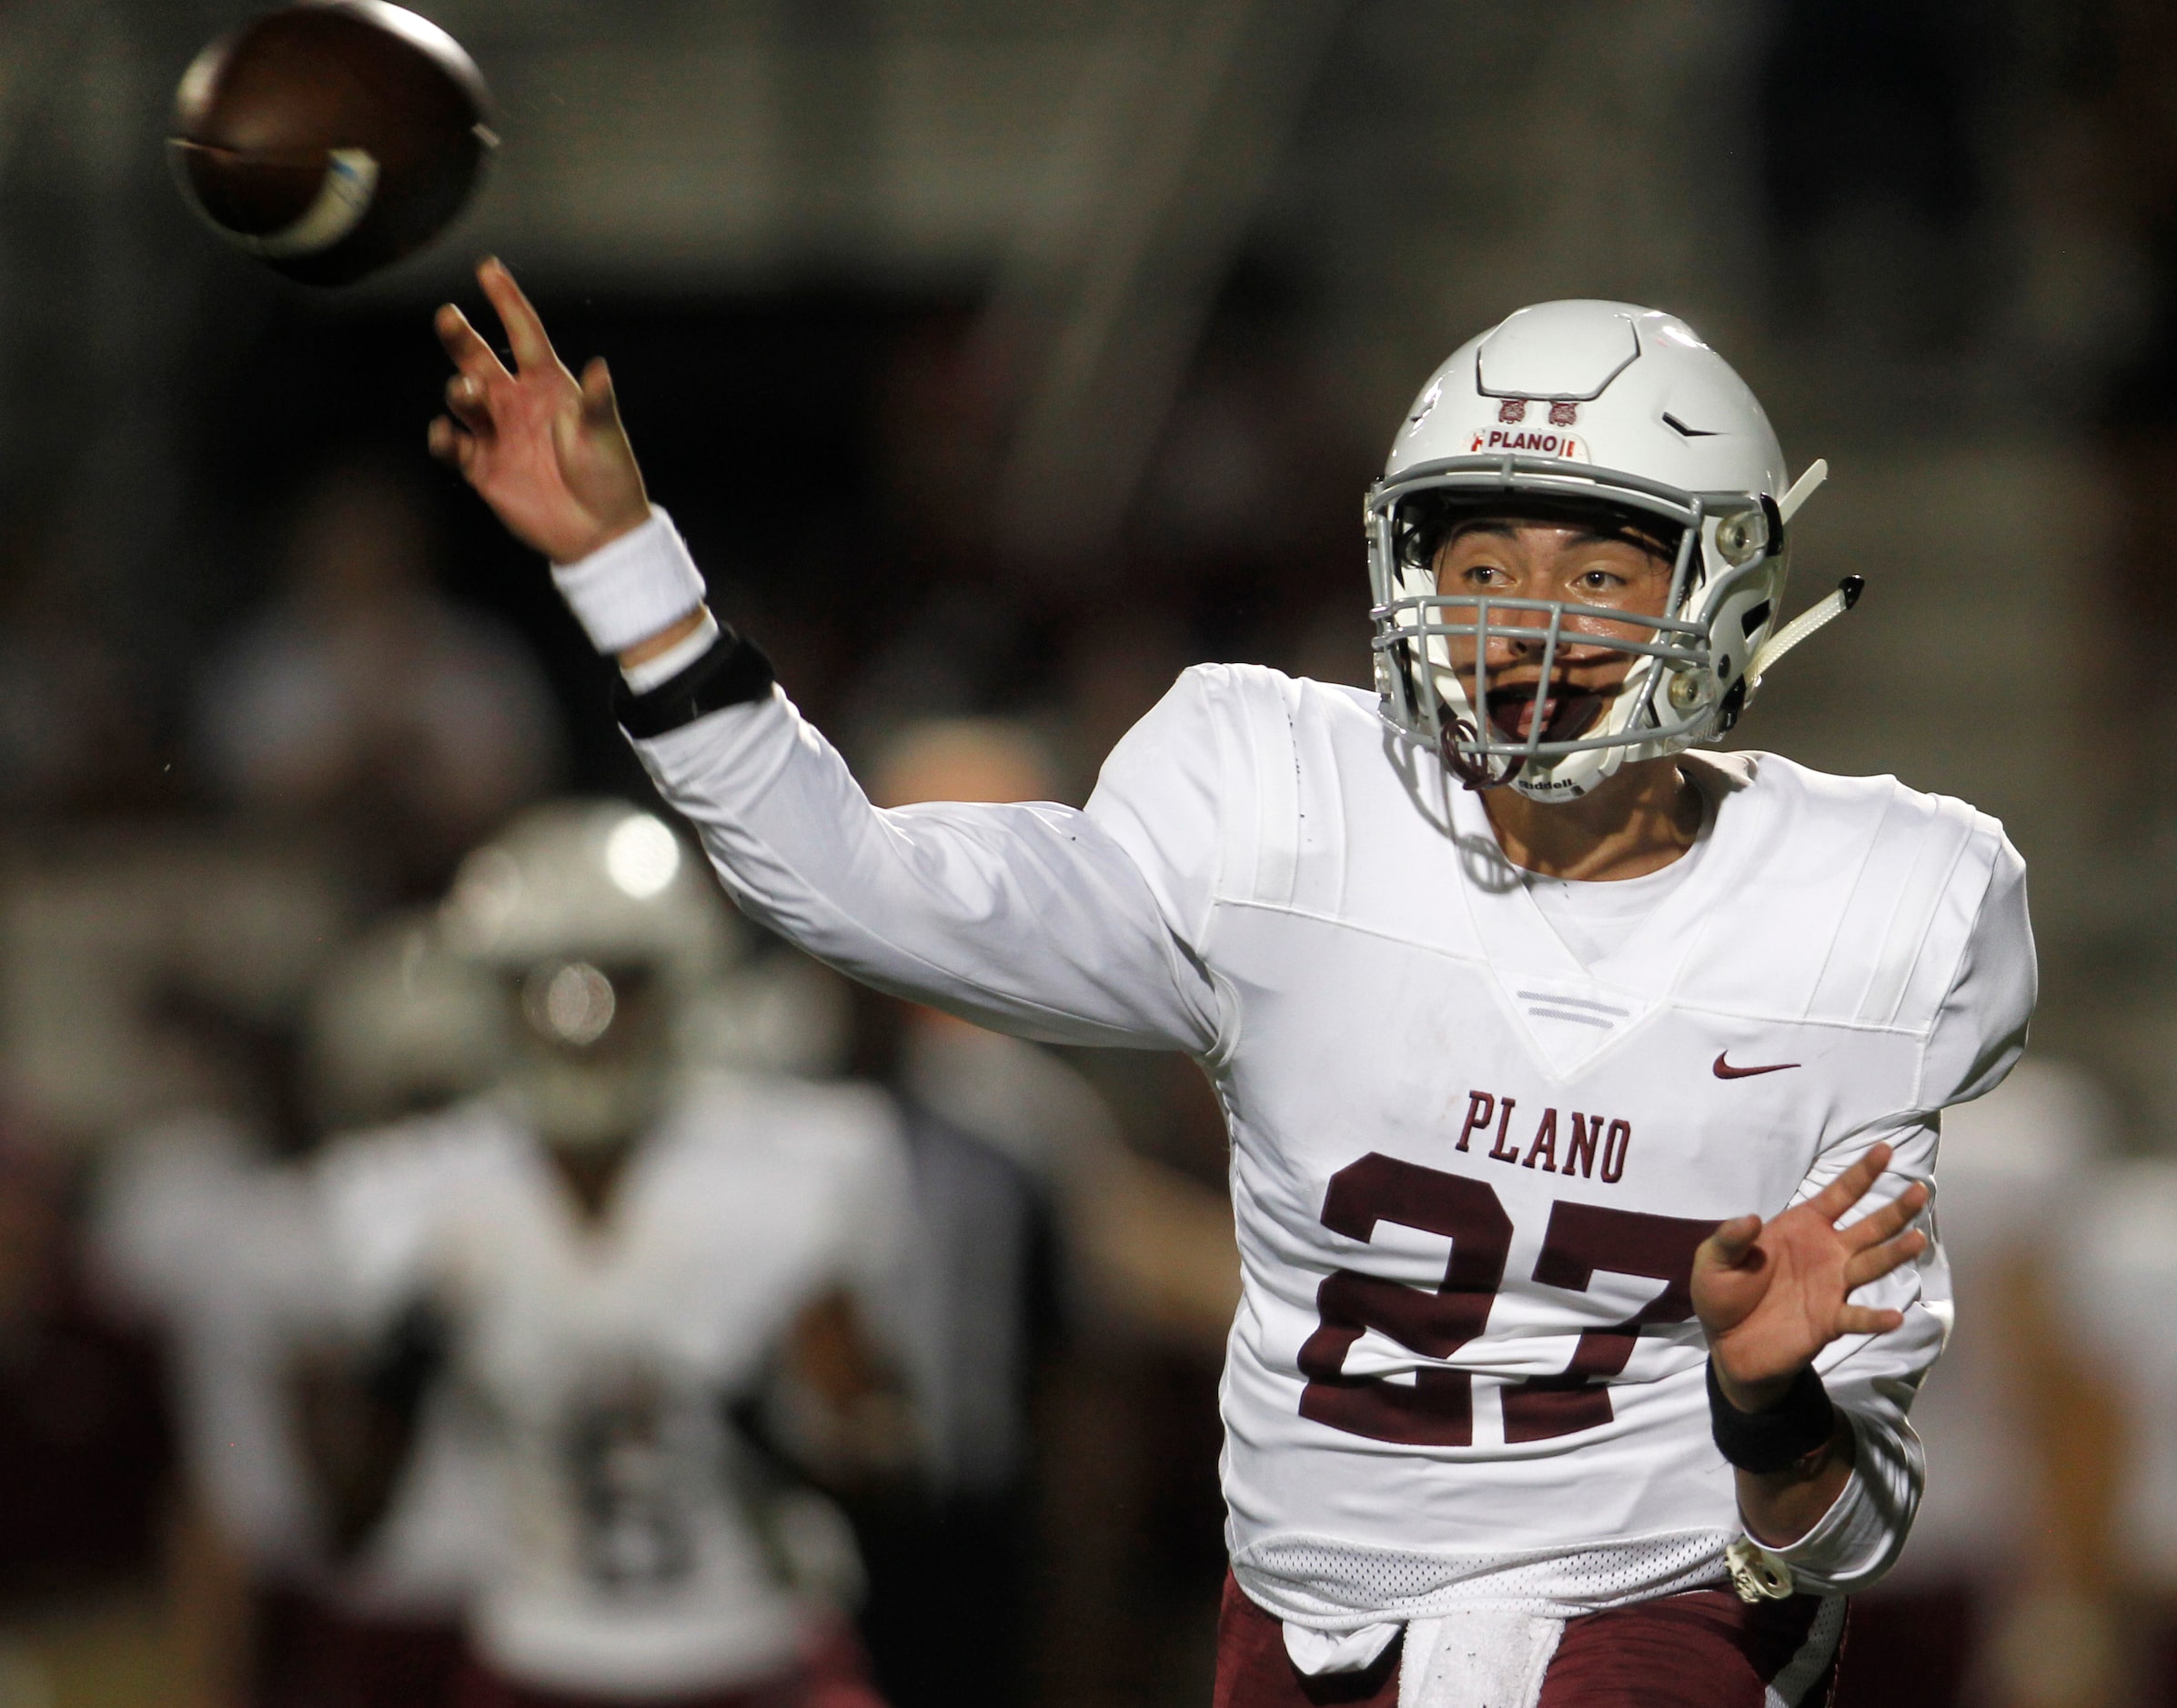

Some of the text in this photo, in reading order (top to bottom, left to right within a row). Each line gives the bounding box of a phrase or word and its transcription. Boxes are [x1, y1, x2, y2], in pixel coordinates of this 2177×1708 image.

[1488, 431, 1557, 452] PLANO
[1455, 1090, 1631, 1184] PLANO
[1297, 1151, 1727, 1446] 27
